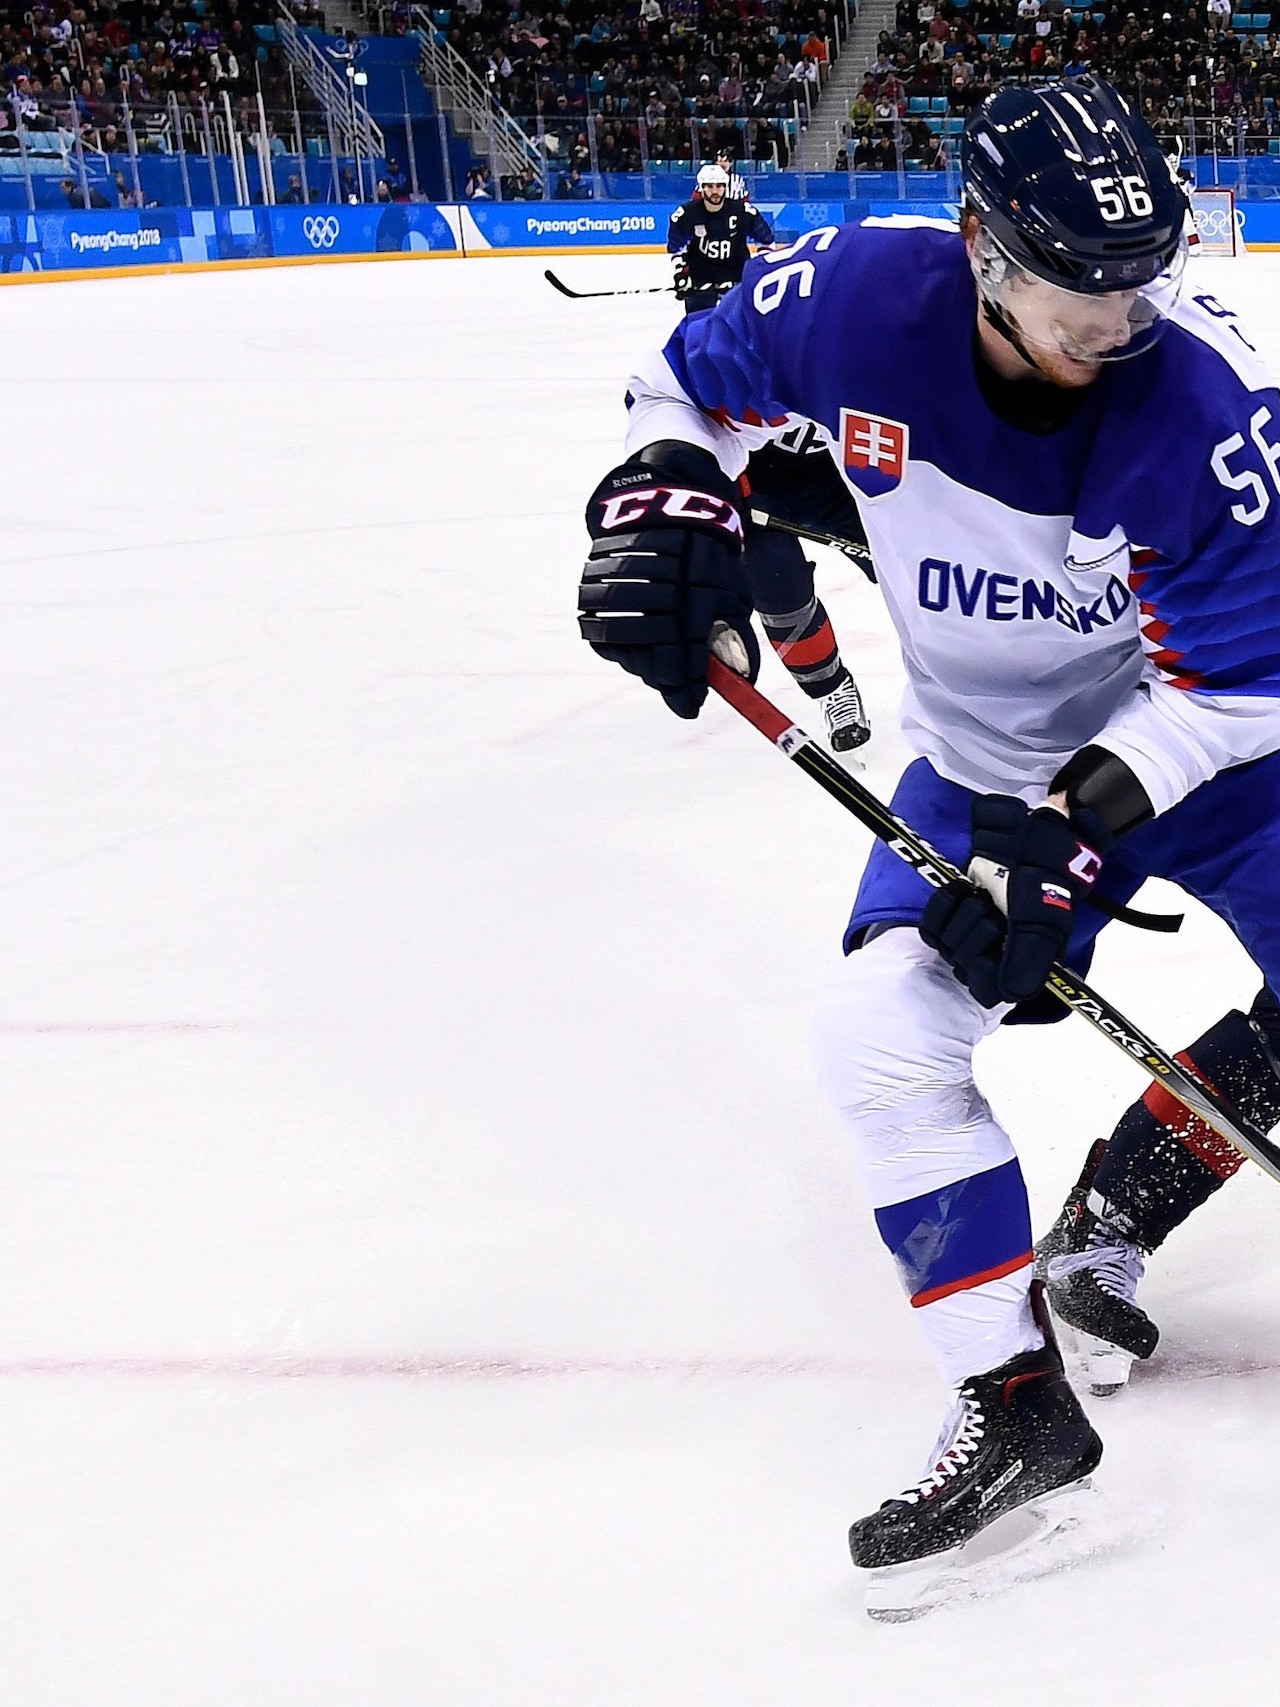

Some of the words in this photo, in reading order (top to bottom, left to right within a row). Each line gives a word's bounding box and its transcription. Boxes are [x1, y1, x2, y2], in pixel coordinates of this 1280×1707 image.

[1090, 175, 1153, 221] 56
[526, 217, 621, 236] PyeongChang
[621, 216, 656, 231] 2018
[728, 215, 738, 230] C
[70, 229, 138, 253] PyeongChang
[137, 228, 162, 247] 2018
[698, 236, 732, 260] USA
[753, 225, 840, 315] 56
[917, 556, 1132, 636] OVENSKO
[1070, 992, 1151, 1059] TACKS
